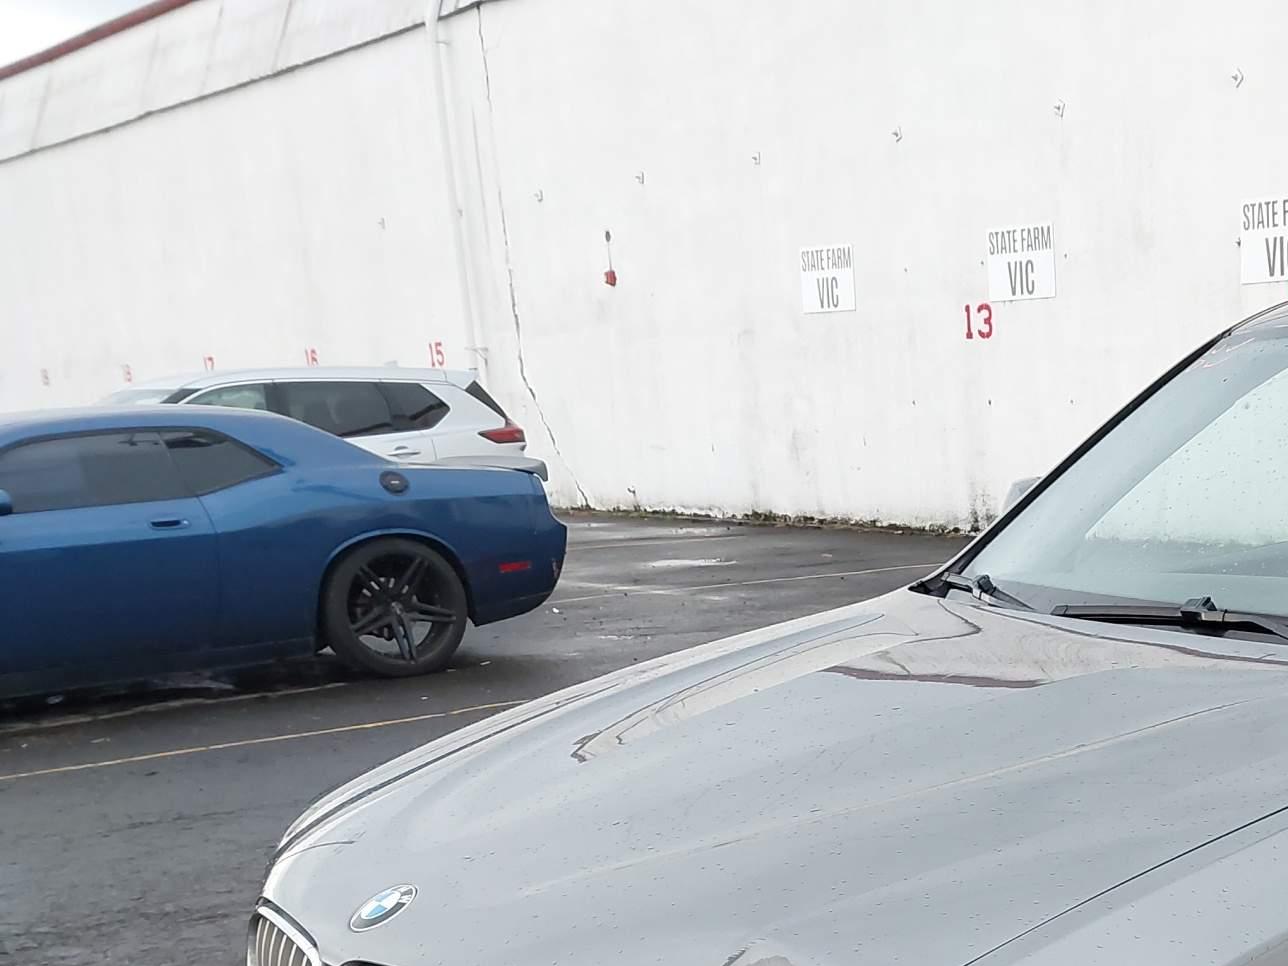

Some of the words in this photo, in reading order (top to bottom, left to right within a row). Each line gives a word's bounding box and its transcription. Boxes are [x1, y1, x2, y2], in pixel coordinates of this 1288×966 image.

[1243, 200, 1278, 231] STATE
[989, 229, 1018, 255] STATE
[1021, 225, 1051, 252] FARM
[801, 249, 825, 272] STATE
[827, 246, 851, 270] FARM
[816, 276, 839, 309] VIC
[1008, 259, 1035, 296] VIC
[964, 303, 993, 339] 13
[428, 342, 445, 367] 15
